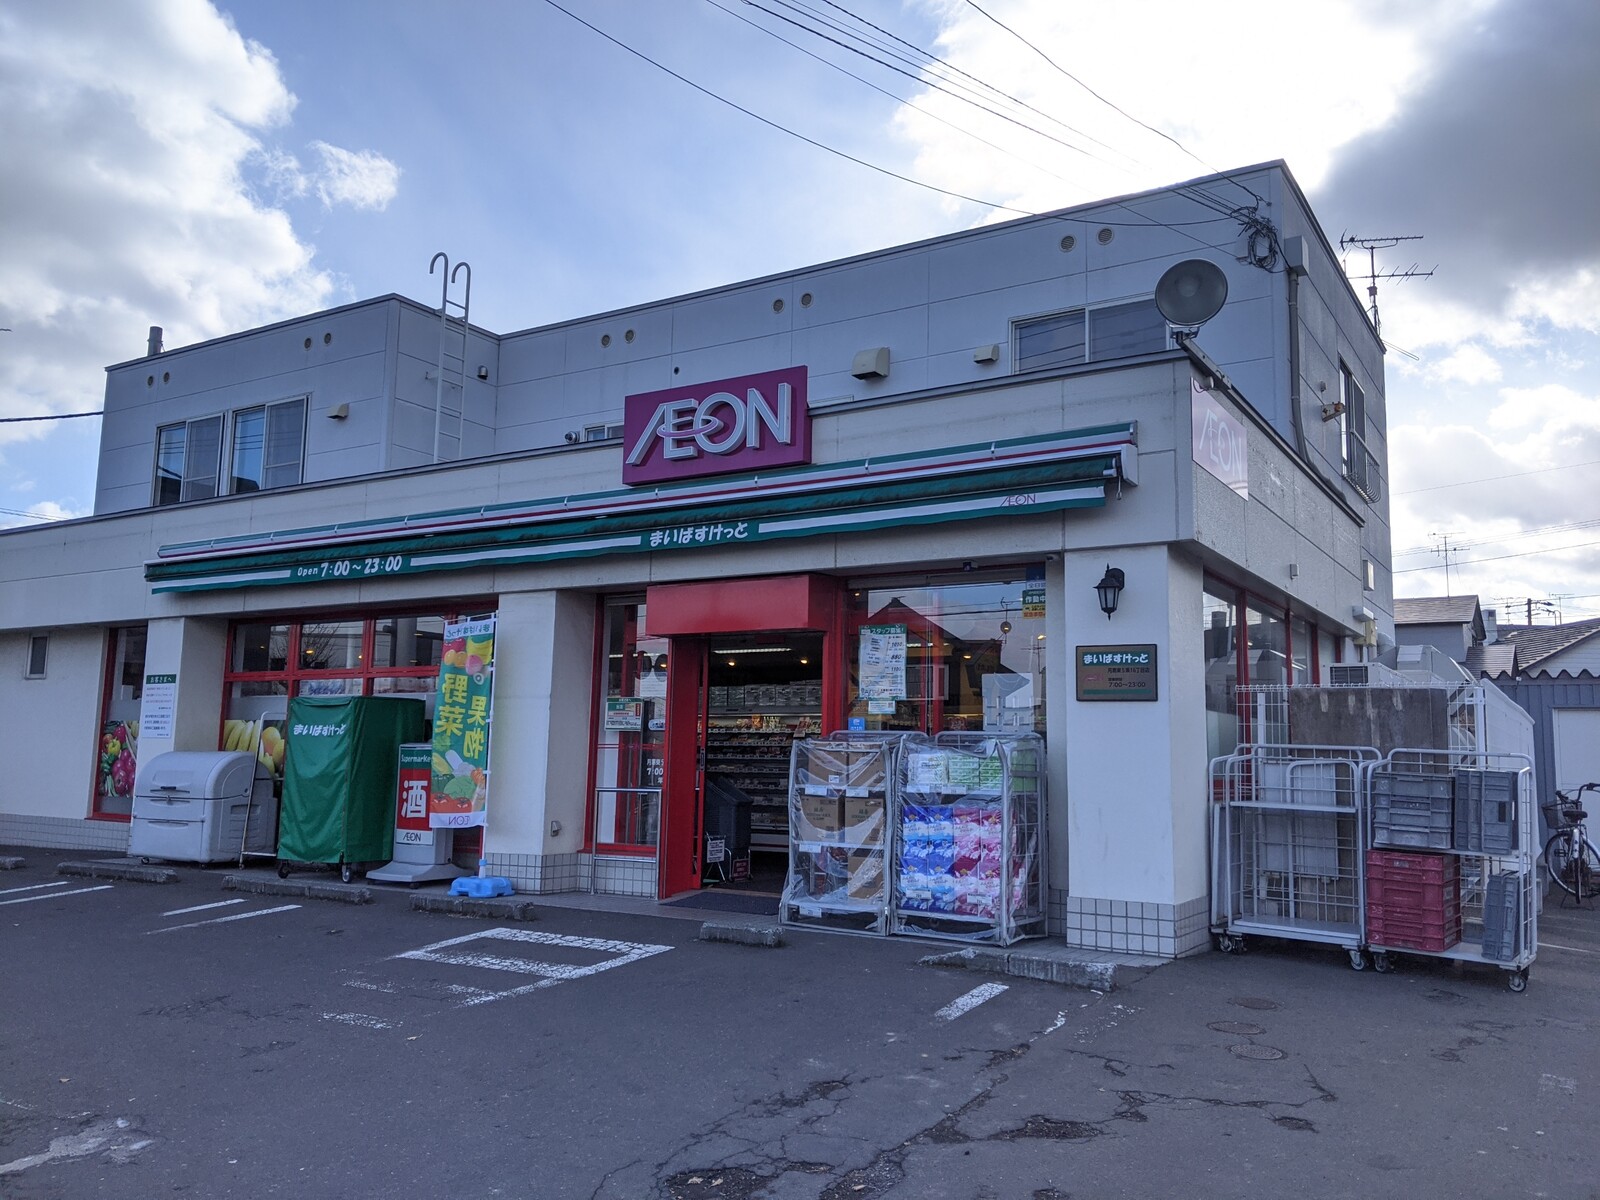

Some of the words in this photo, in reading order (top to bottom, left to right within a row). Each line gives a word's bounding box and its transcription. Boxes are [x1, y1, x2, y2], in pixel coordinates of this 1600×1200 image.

[649, 522, 748, 547] まいばすけっと
[297, 567, 318, 577] Open
[1083, 653, 1149, 664] まいばすけっと
[293, 723, 347, 737] まいばすけっと
[401, 780, 428, 818] 酒
